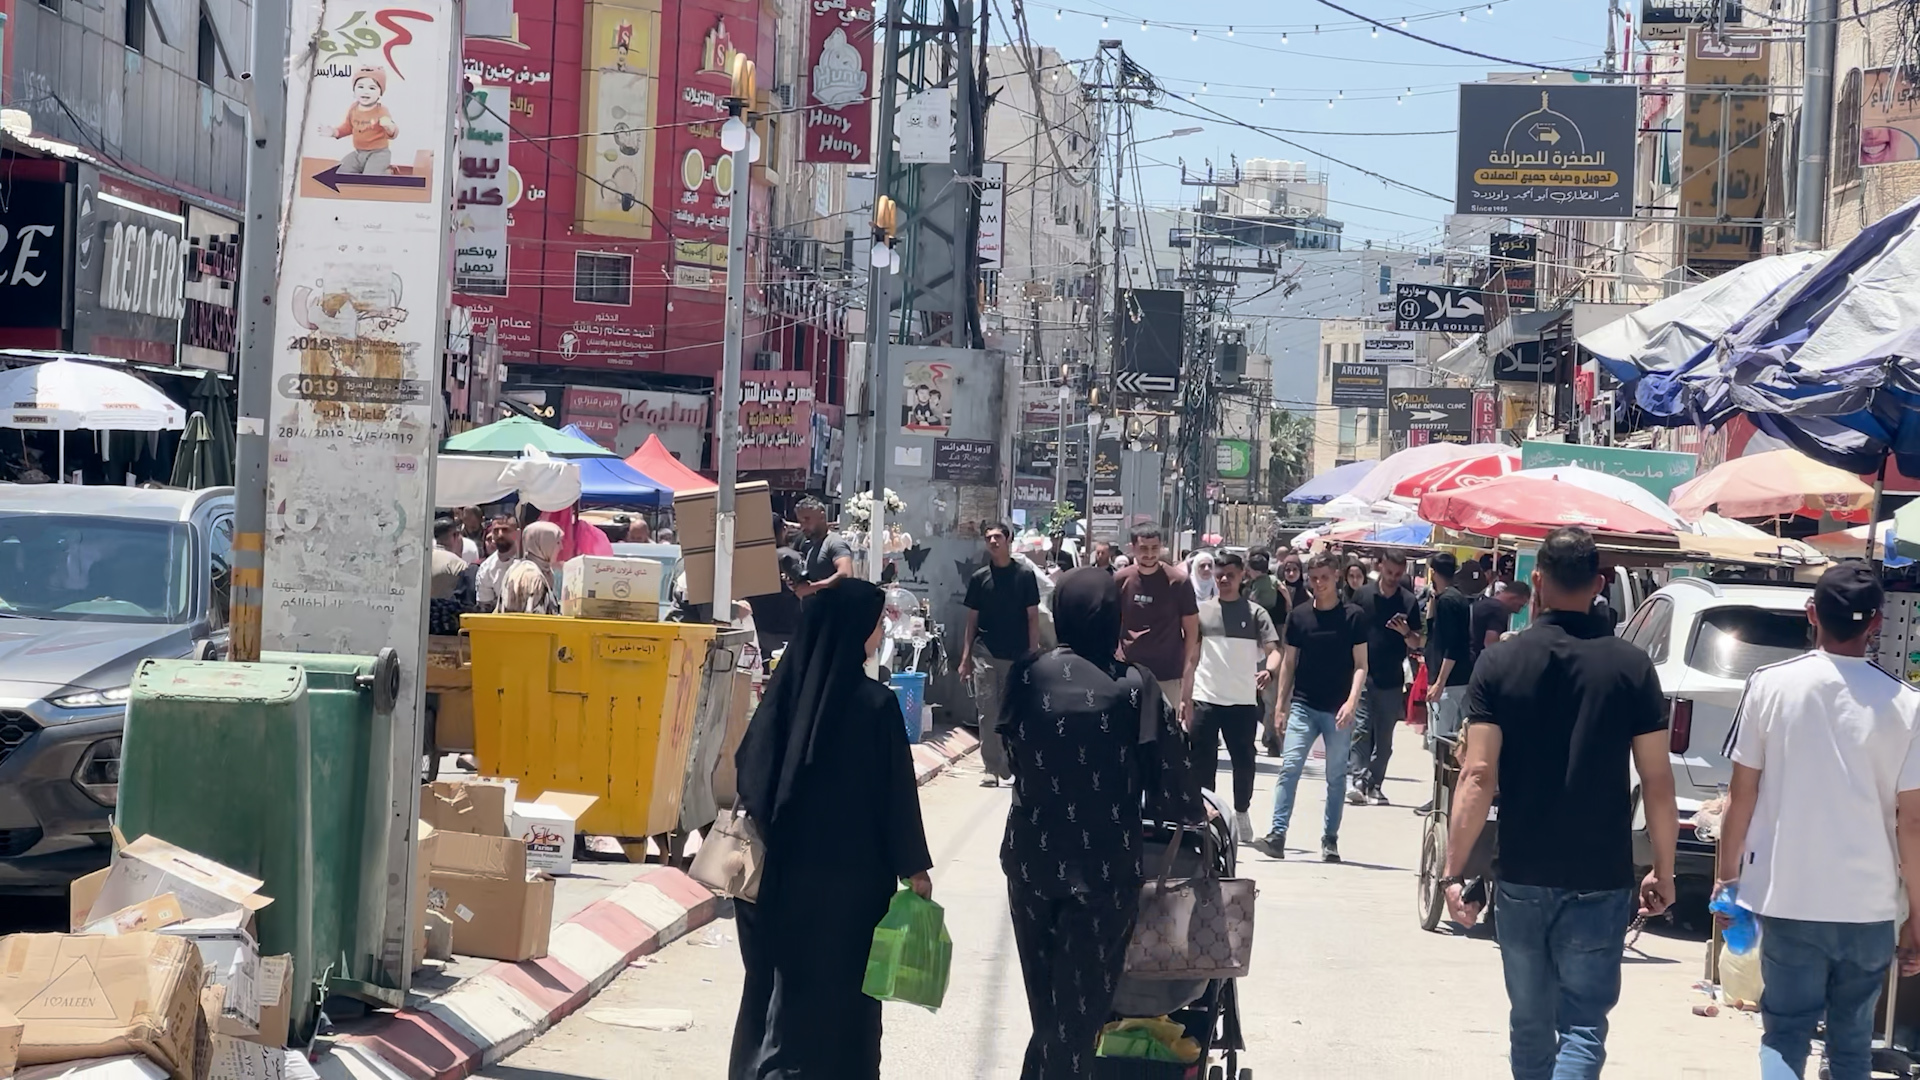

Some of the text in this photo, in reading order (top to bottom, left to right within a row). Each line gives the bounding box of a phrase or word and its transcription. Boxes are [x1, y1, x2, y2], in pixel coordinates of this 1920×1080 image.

[818, 67, 866, 88] Huny
[808, 109, 852, 134] Huny
[818, 134, 862, 160] Huny
[1489, 150, 1605, 169] الصخرة للصرافة
[1480, 170, 1518, 181] العملات
[1520, 173, 1546, 184] جميع
[1549, 173, 1573, 184] صرف
[1582, 173, 1611, 184] تحويل
[527, 184, 546, 201] من
[1471, 204, 1492, 212] Since
[108, 221, 147, 313] RED
[460, 263, 494, 275] تجميل
[500, 316, 532, 329] عصام
[595, 312, 619, 322] الدكتور
[1400, 321, 1485, 332] HALA SOIREE
[1341, 366, 1380, 376] ARIZONA
[287, 377, 339, 395] 2019
[61, 997, 96, 1009] ALEEN
